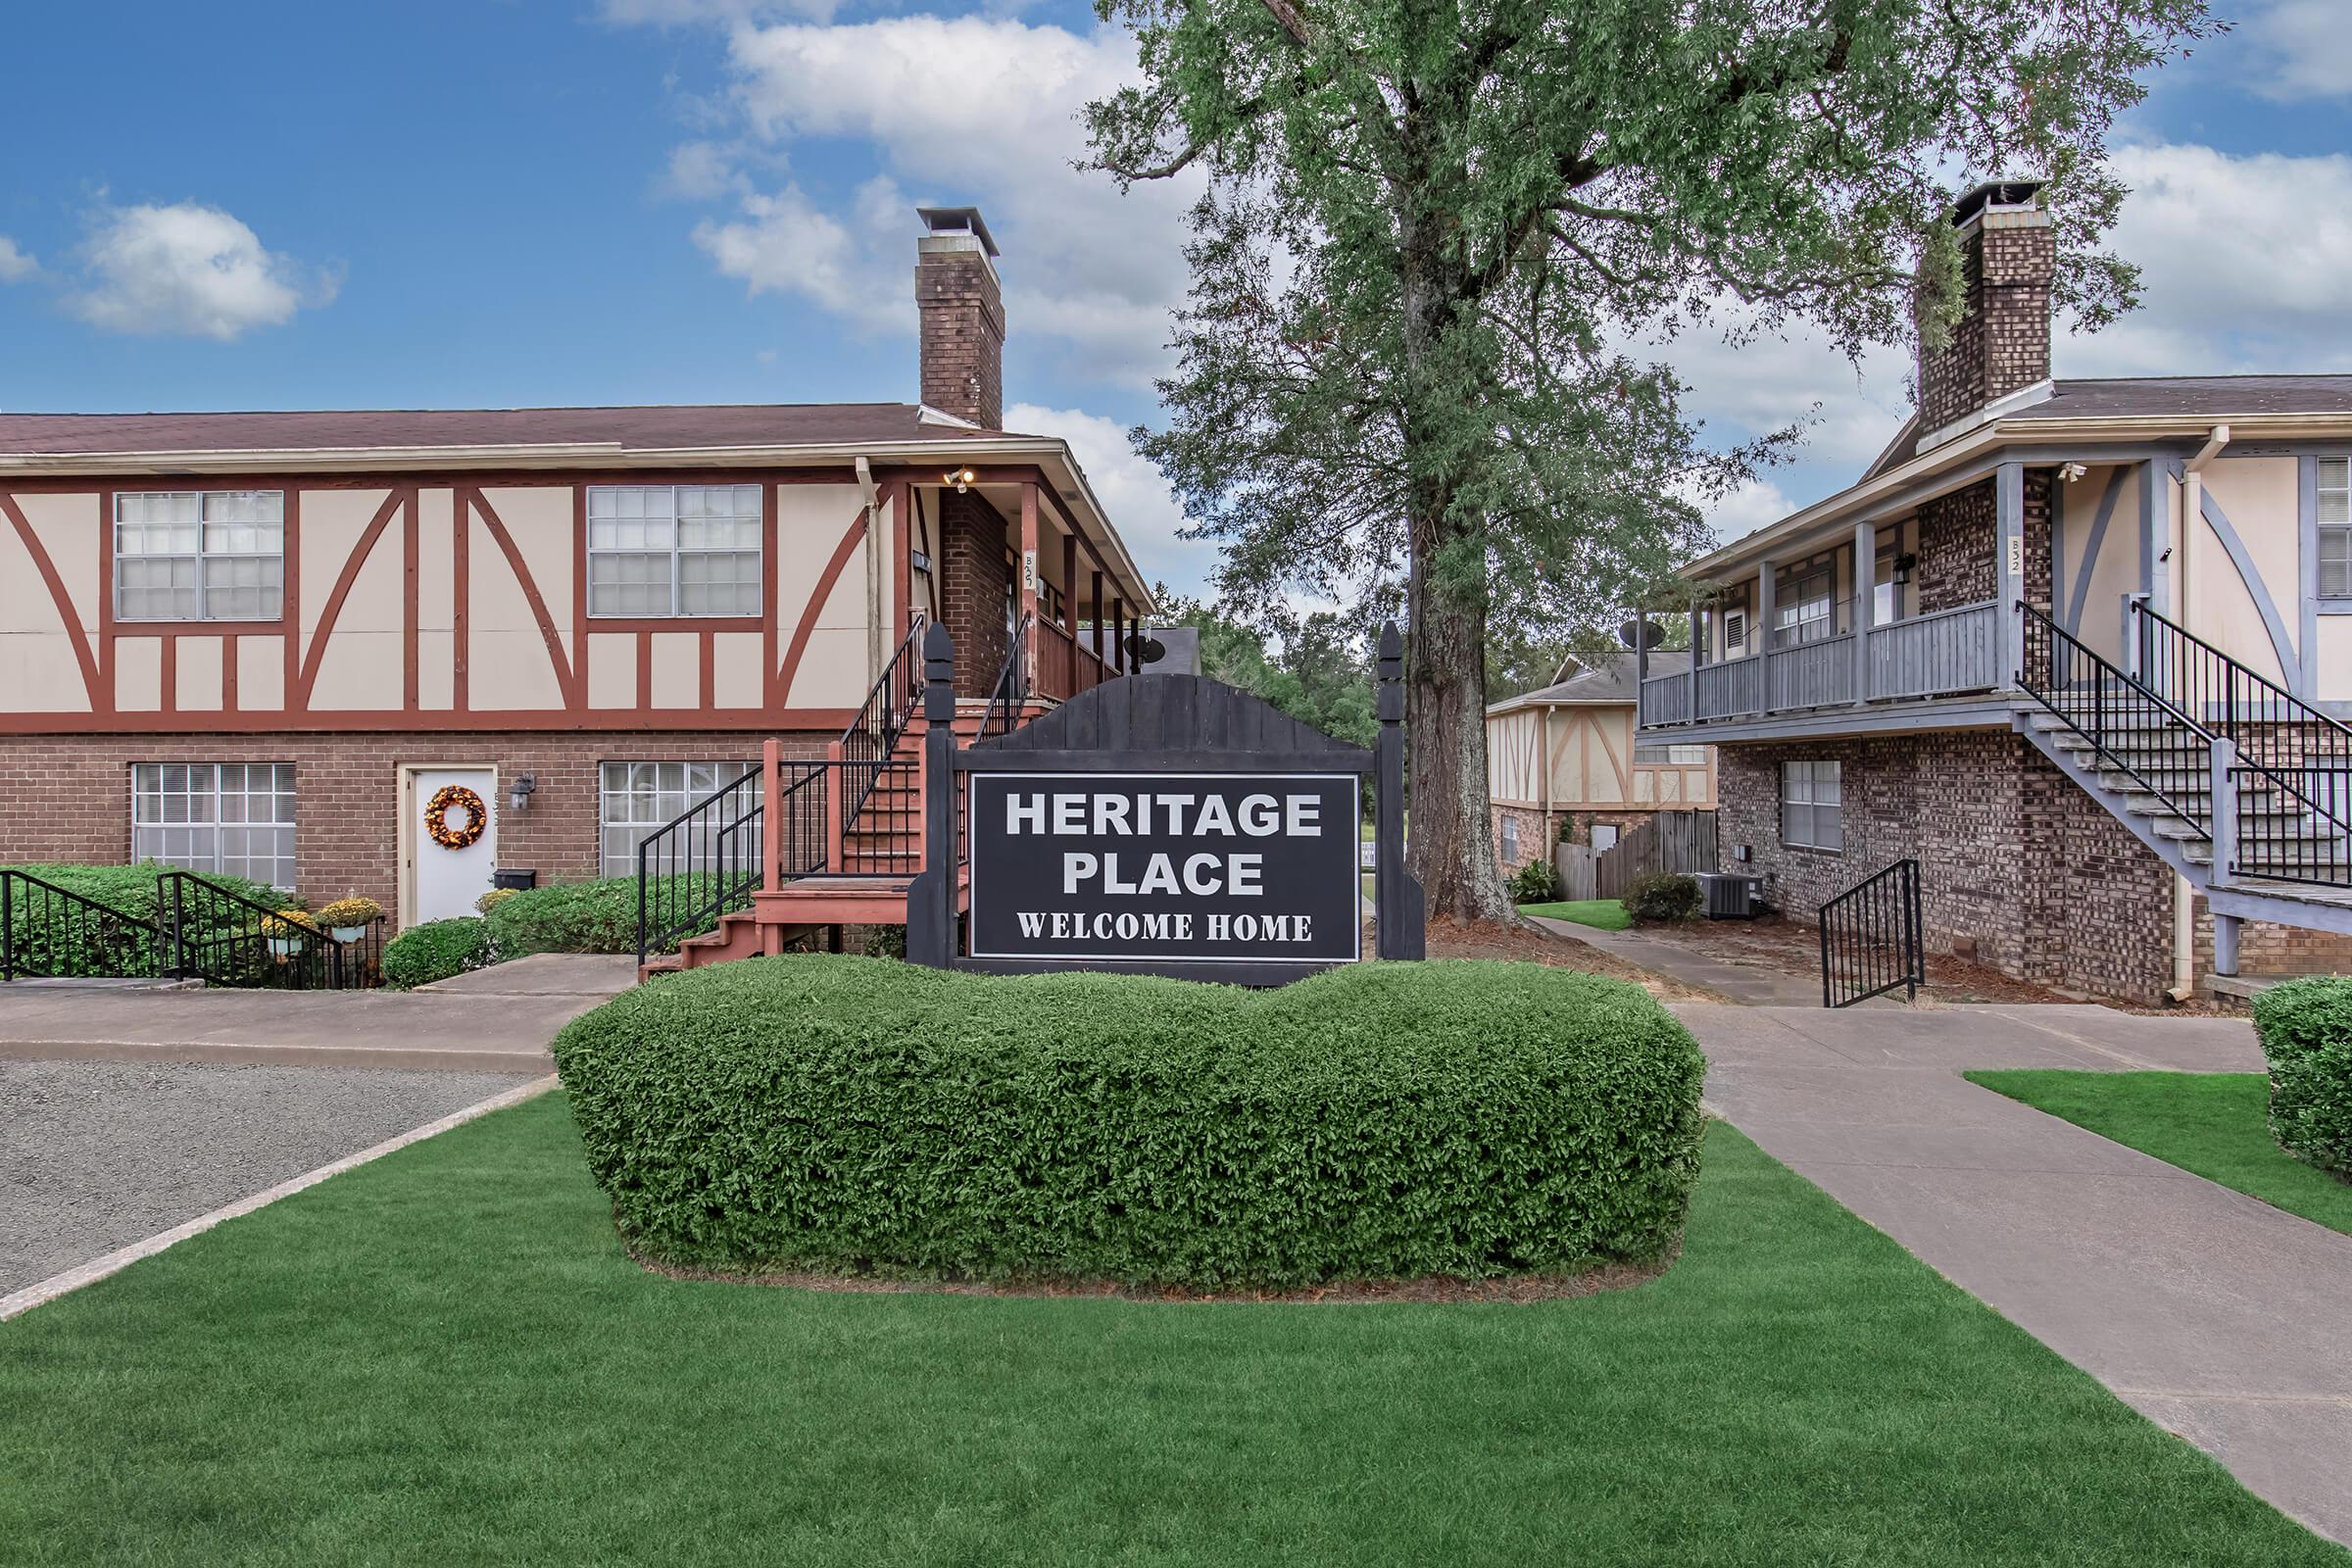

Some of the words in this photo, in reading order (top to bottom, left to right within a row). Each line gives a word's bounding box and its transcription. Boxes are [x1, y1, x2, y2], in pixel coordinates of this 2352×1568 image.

[1006, 793, 1321, 836] HERITAGE
[1063, 853, 1263, 896] PLACE
[1016, 912, 1194, 941] WELCOME
[1206, 914, 1312, 943] HOME
